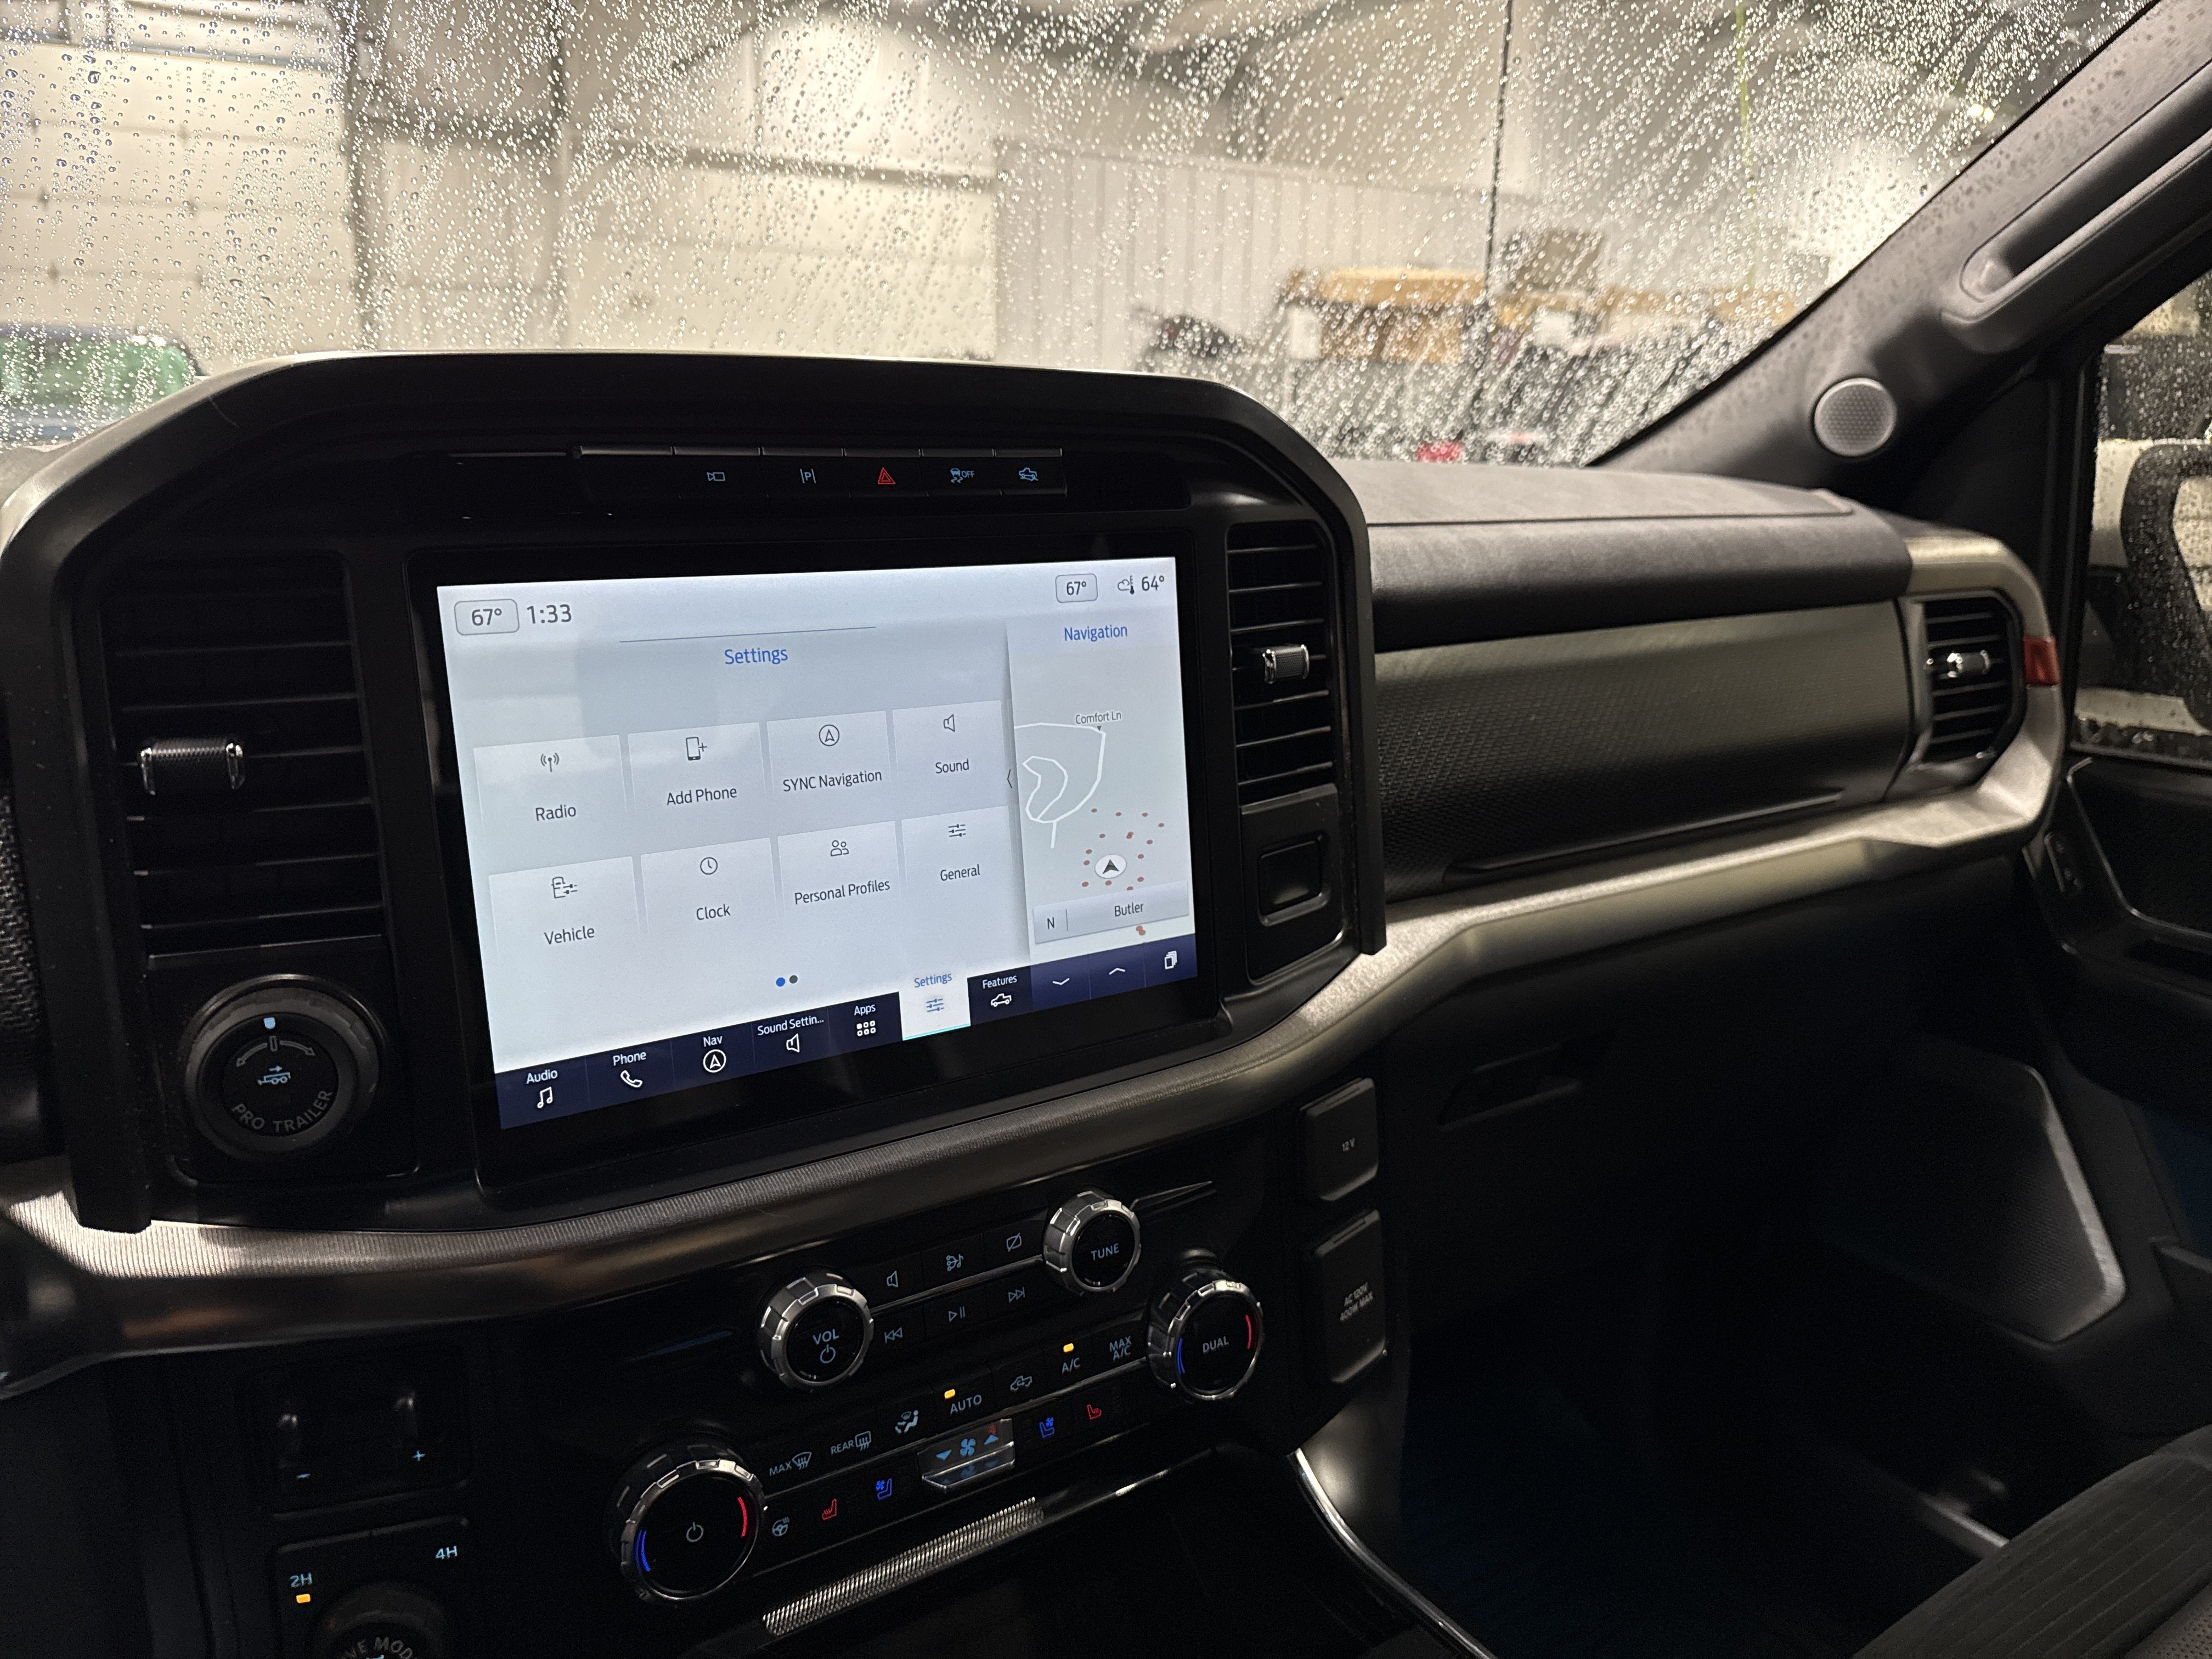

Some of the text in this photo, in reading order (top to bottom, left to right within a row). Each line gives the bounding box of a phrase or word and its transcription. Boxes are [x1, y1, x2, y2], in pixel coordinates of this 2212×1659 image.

[1066, 580, 1087, 596] 67°
[1141, 575, 1165, 591] 64°
[471, 604, 572, 627] 67° 1:33
[1064, 624, 1128, 642] Navigation
[724, 647, 788, 665] Settings
[1075, 711, 1121, 724] Comfort Ln
[935, 758, 970, 775] Sound
[782, 770, 882, 792] SYNC Navigation
[667, 787, 737, 806] Add Phone
[535, 804, 577, 821] Radio
[940, 864, 981, 882] General
[794, 879, 890, 905] Personal Profiles
[696, 904, 731, 921] Clock
[1114, 902, 1144, 917] Butler
[1047, 917, 1055, 929] N
[544, 926, 595, 945] Vehicle
[913, 972, 952, 989] Settings
[982, 974, 1018, 989] Features
[854, 1004, 876, 1017] Apps
[757, 1020, 788, 1036] Sound
[703, 1035, 723, 1047] Nav
[612, 1050, 647, 1066] Phone
[526, 1068, 558, 1084] Audio
[232, 1091, 333, 1133] PRO TRAILER
[1090, 1243, 1120, 1260] TUNE
[812, 1328, 839, 1345] VOL
[1109, 1335, 1132, 1352] MAX
[1202, 1336, 1229, 1353] DUAL
[1113, 1345, 1131, 1361] A/C
[1062, 1357, 1080, 1374] A/C
[950, 1394, 982, 1415] AUTO
[830, 1440, 855, 1455] REAR
[769, 1460, 793, 1476] MAX
[435, 1545, 458, 1560] 4H
[289, 1572, 313, 1588] 2H
